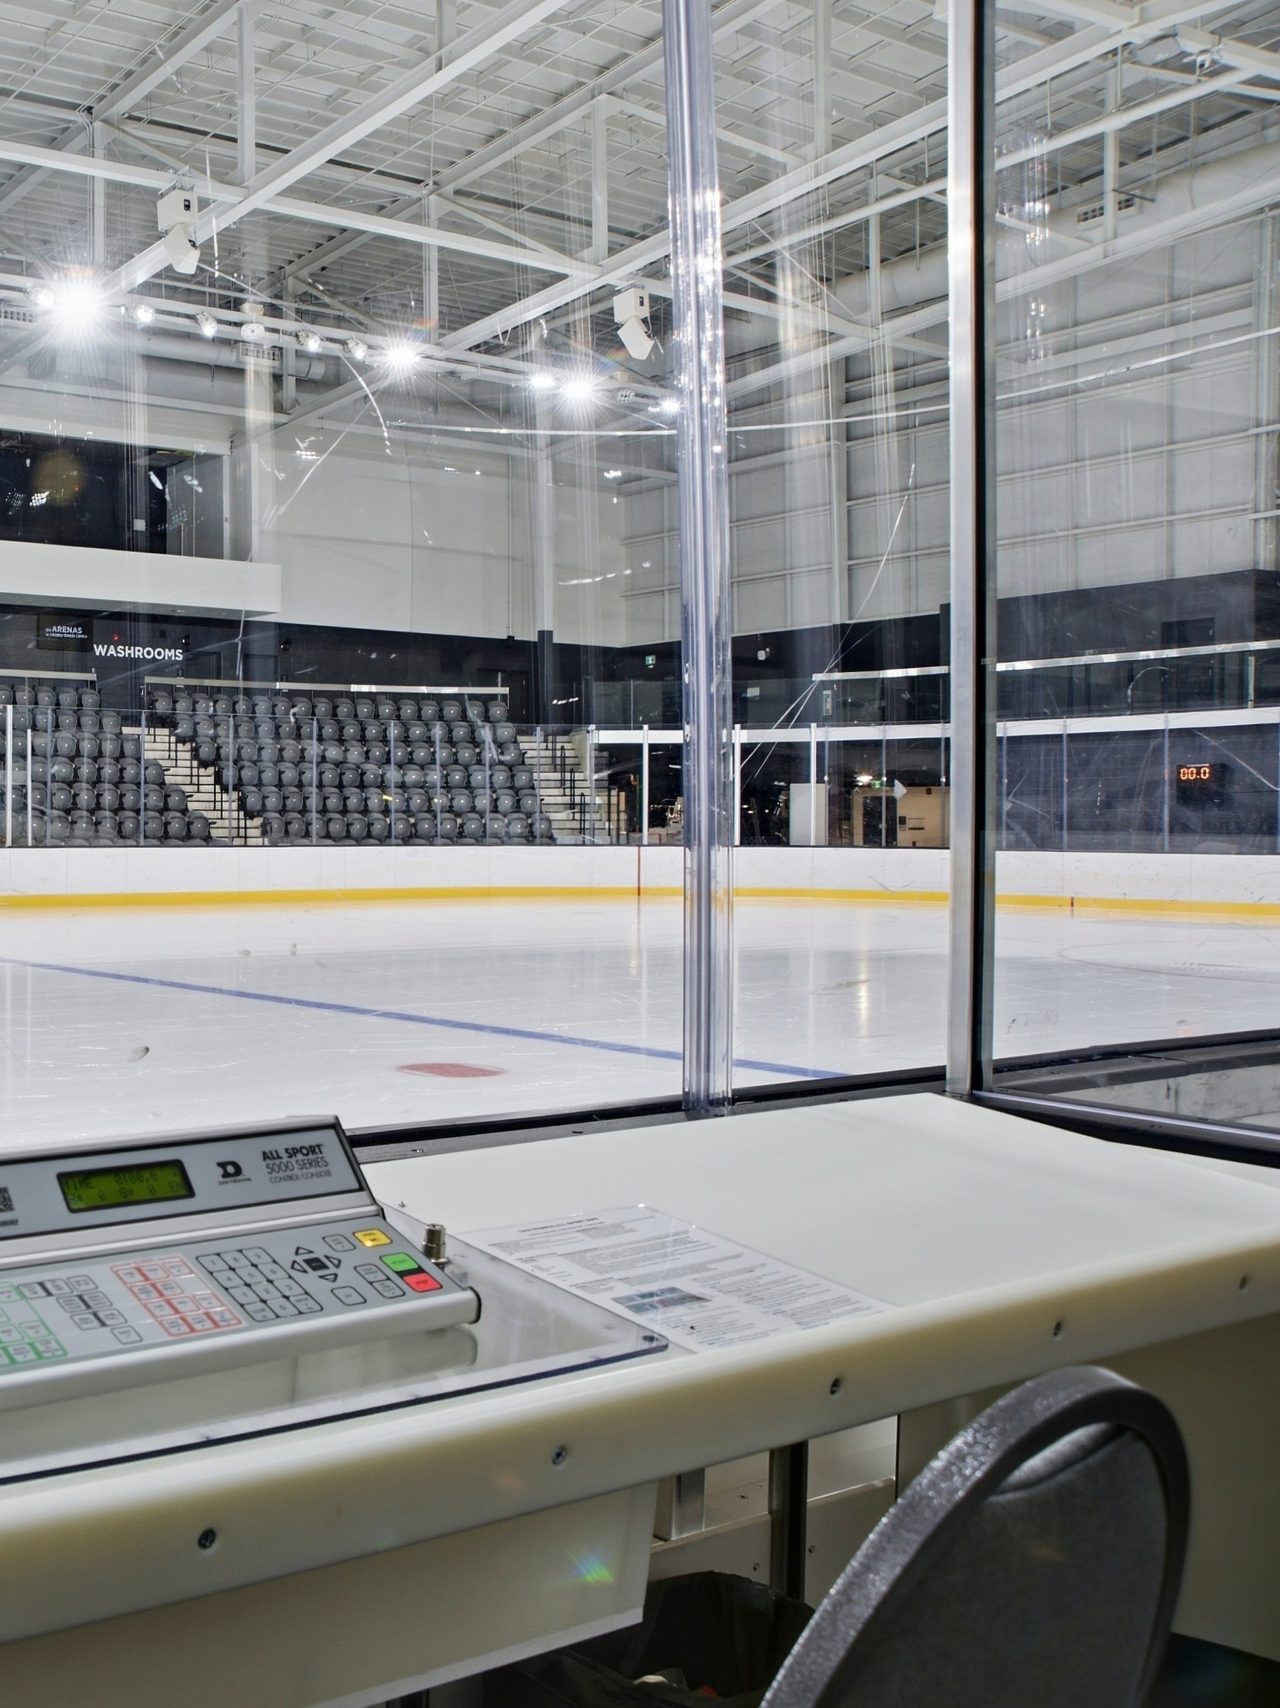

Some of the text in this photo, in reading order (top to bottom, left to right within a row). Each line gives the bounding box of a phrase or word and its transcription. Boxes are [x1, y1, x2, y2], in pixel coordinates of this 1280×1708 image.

[51, 625, 83, 634] ARENAS
[93, 643, 183, 661] WASHROOMS
[262, 1143, 324, 1162] ALL SPORT
[265, 1156, 330, 1176] 5000 SERIES
